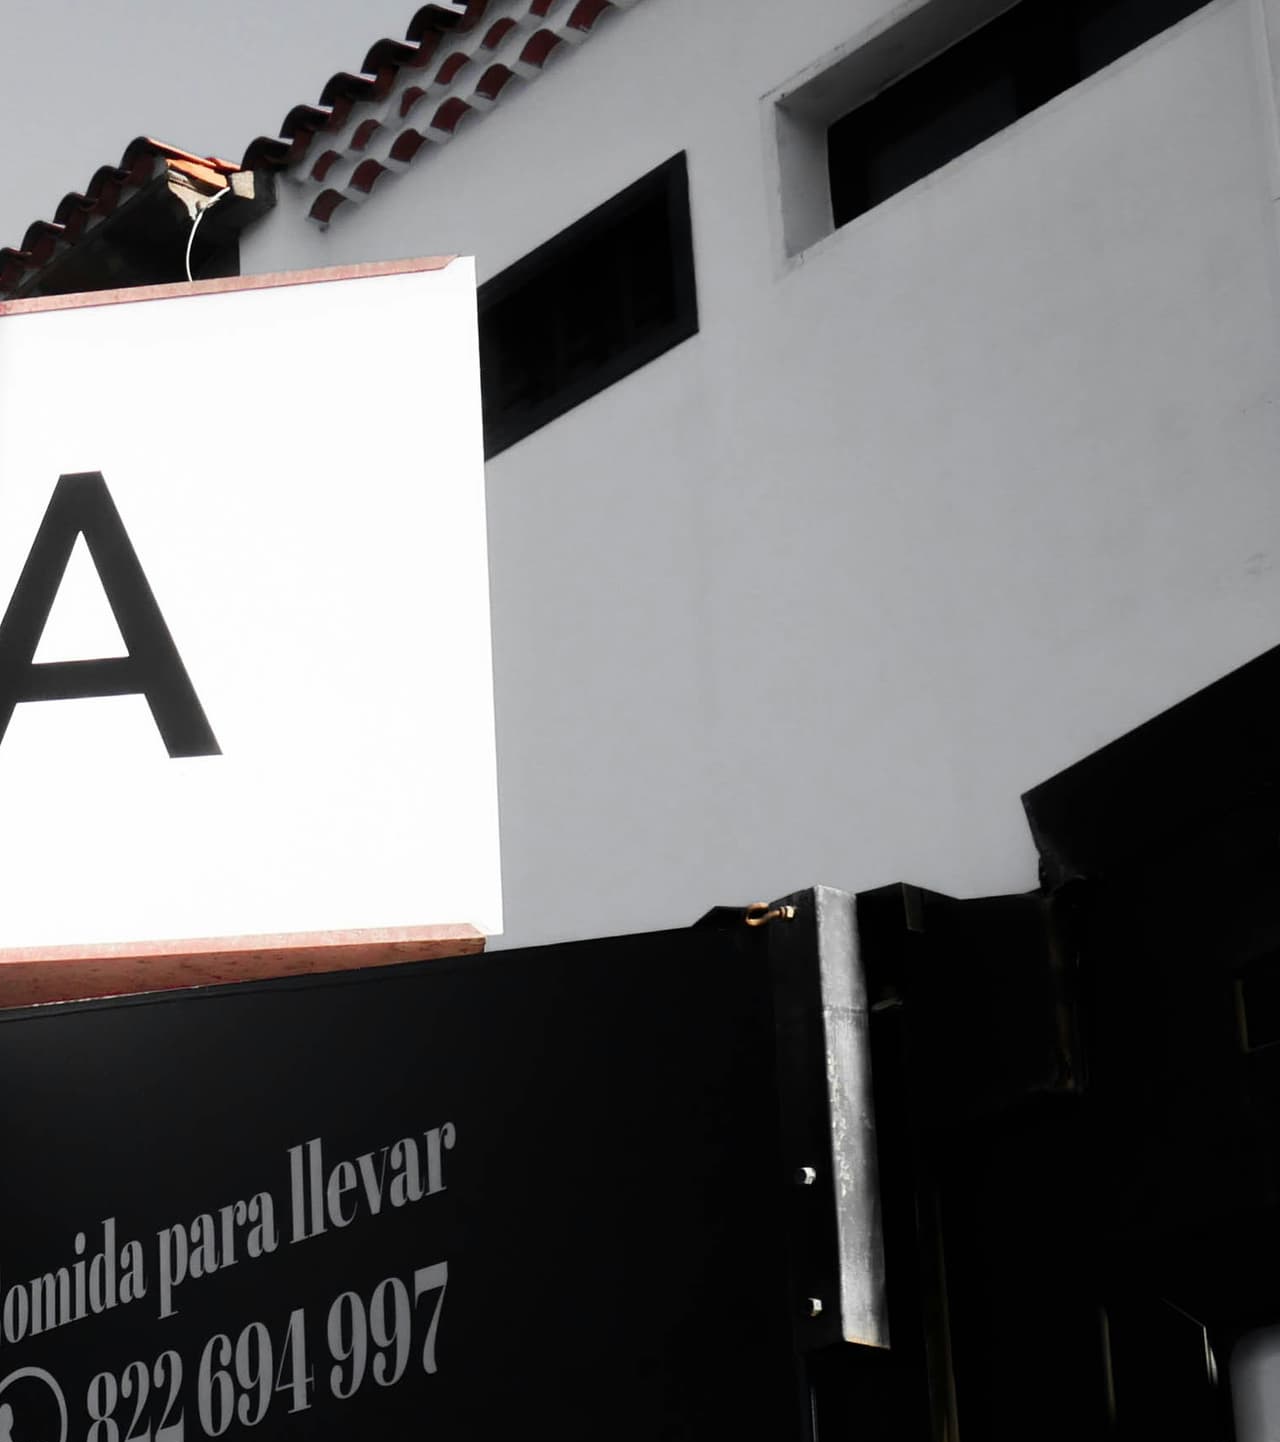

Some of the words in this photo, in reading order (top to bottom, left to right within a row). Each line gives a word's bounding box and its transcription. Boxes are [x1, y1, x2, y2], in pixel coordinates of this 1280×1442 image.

[157, 1191, 280, 1319] para
[286, 1121, 456, 1244] llevar
[197, 1307, 315, 1437] 694
[327, 1260, 449, 1399] 997
